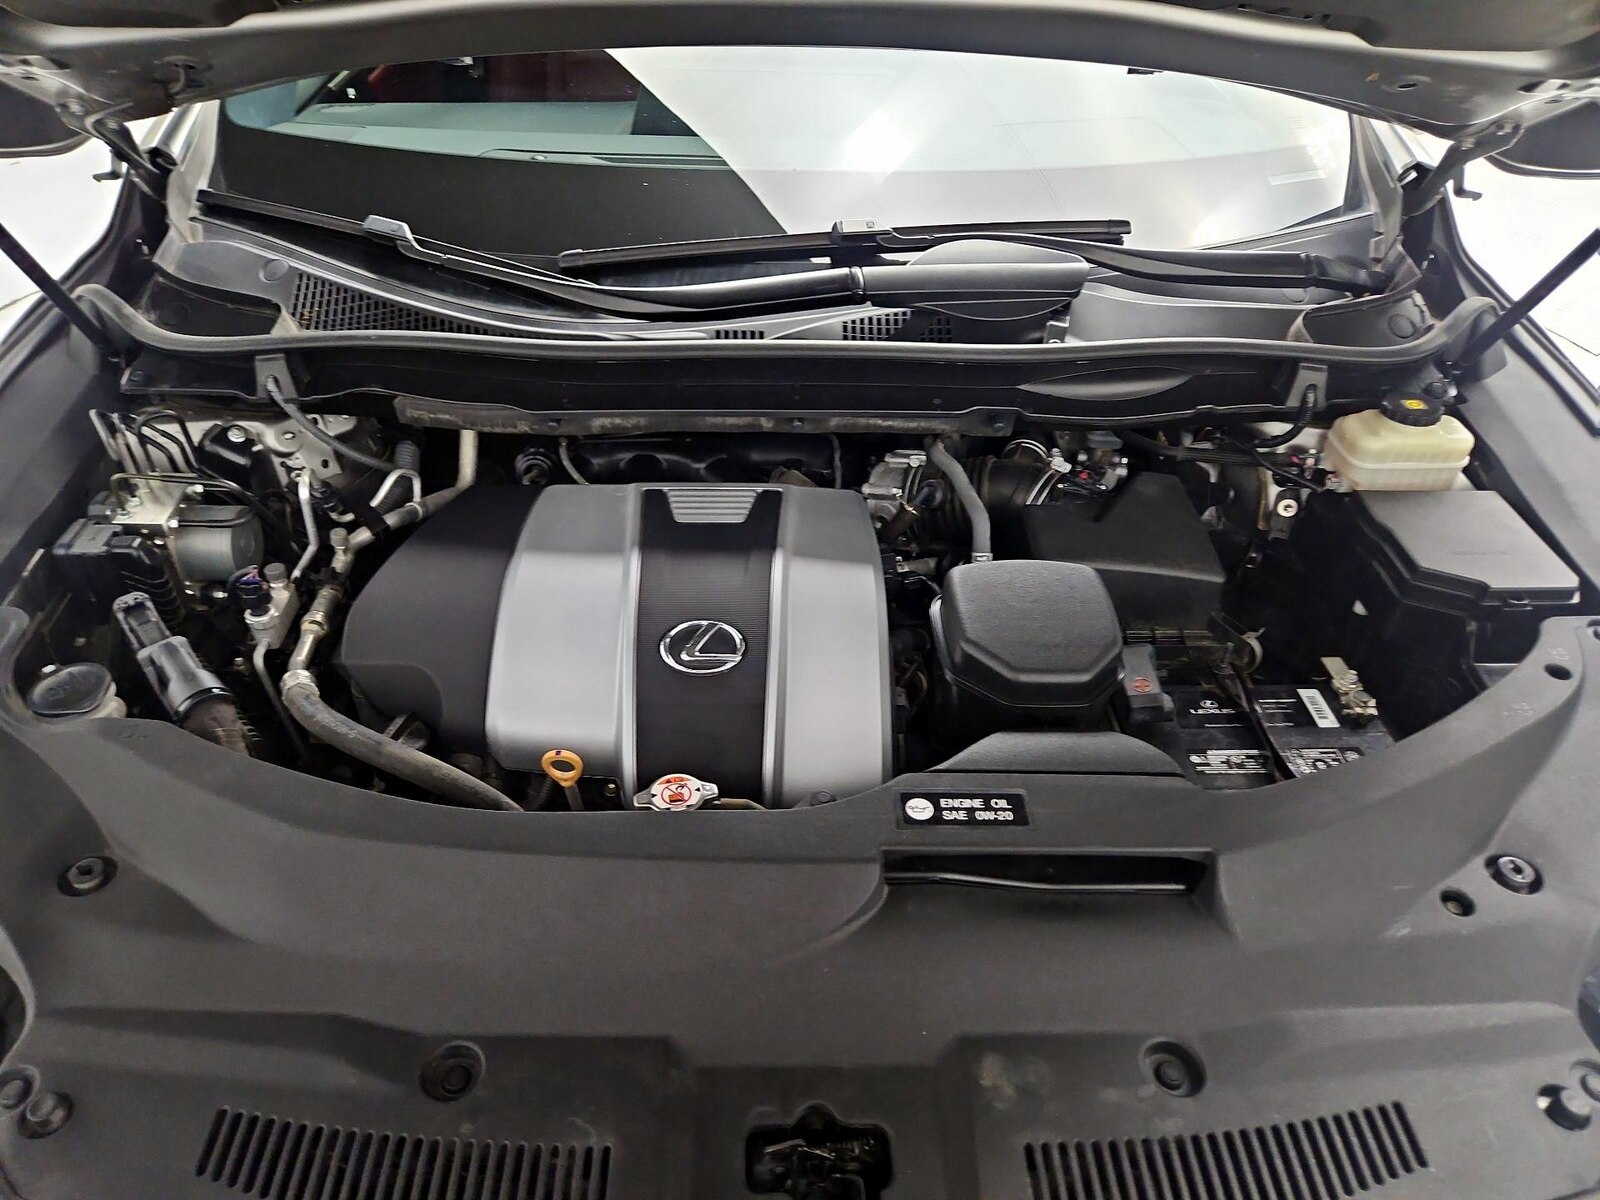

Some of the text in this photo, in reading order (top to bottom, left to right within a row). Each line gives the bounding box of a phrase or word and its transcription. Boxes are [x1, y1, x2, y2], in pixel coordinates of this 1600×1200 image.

[939, 798, 1013, 808] ENGINE OIL
[942, 810, 1014, 821] SAE 0W-20
